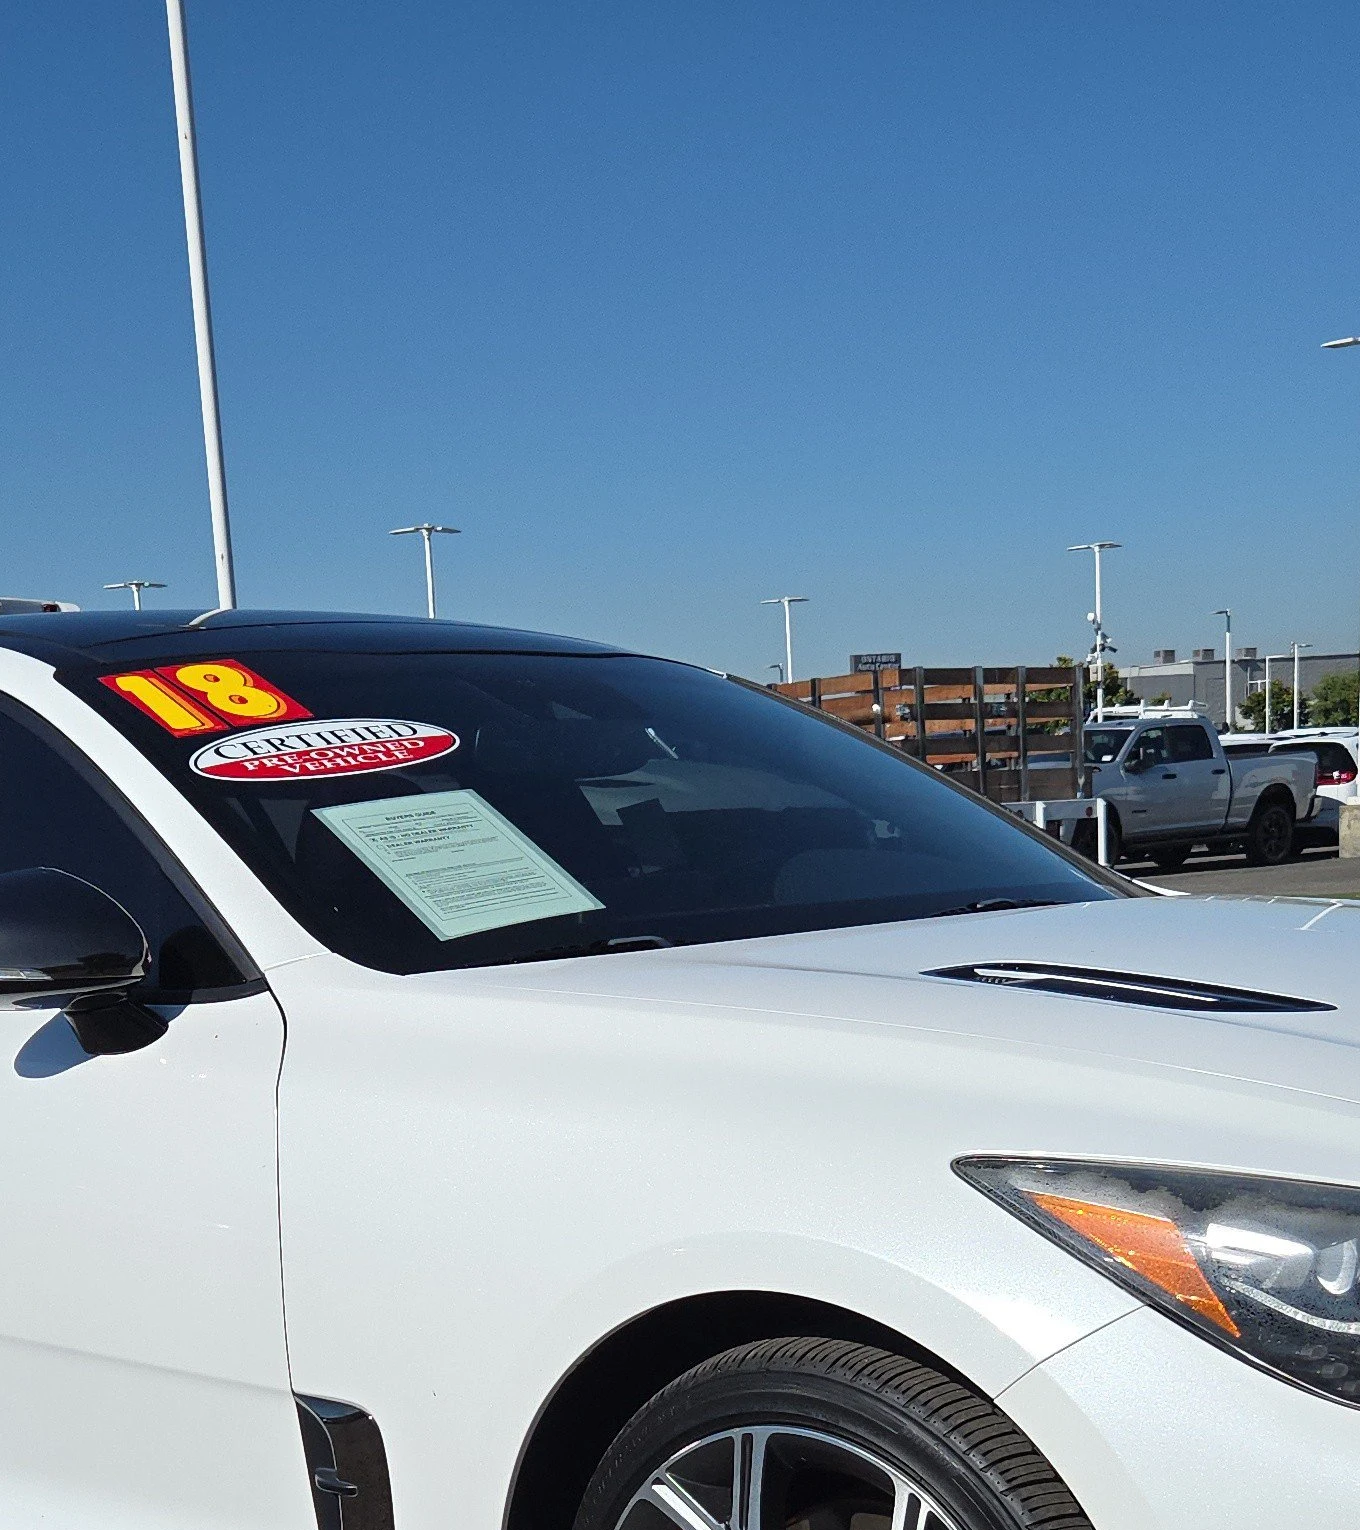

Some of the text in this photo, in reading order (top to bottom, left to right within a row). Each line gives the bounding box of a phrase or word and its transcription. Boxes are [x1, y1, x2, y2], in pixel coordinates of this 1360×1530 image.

[115, 664, 288, 731] 18
[213, 722, 419, 760] CERTIFIED
[240, 739, 425, 772] PRE-OWNED
[280, 751, 414, 774] VEHICLE
